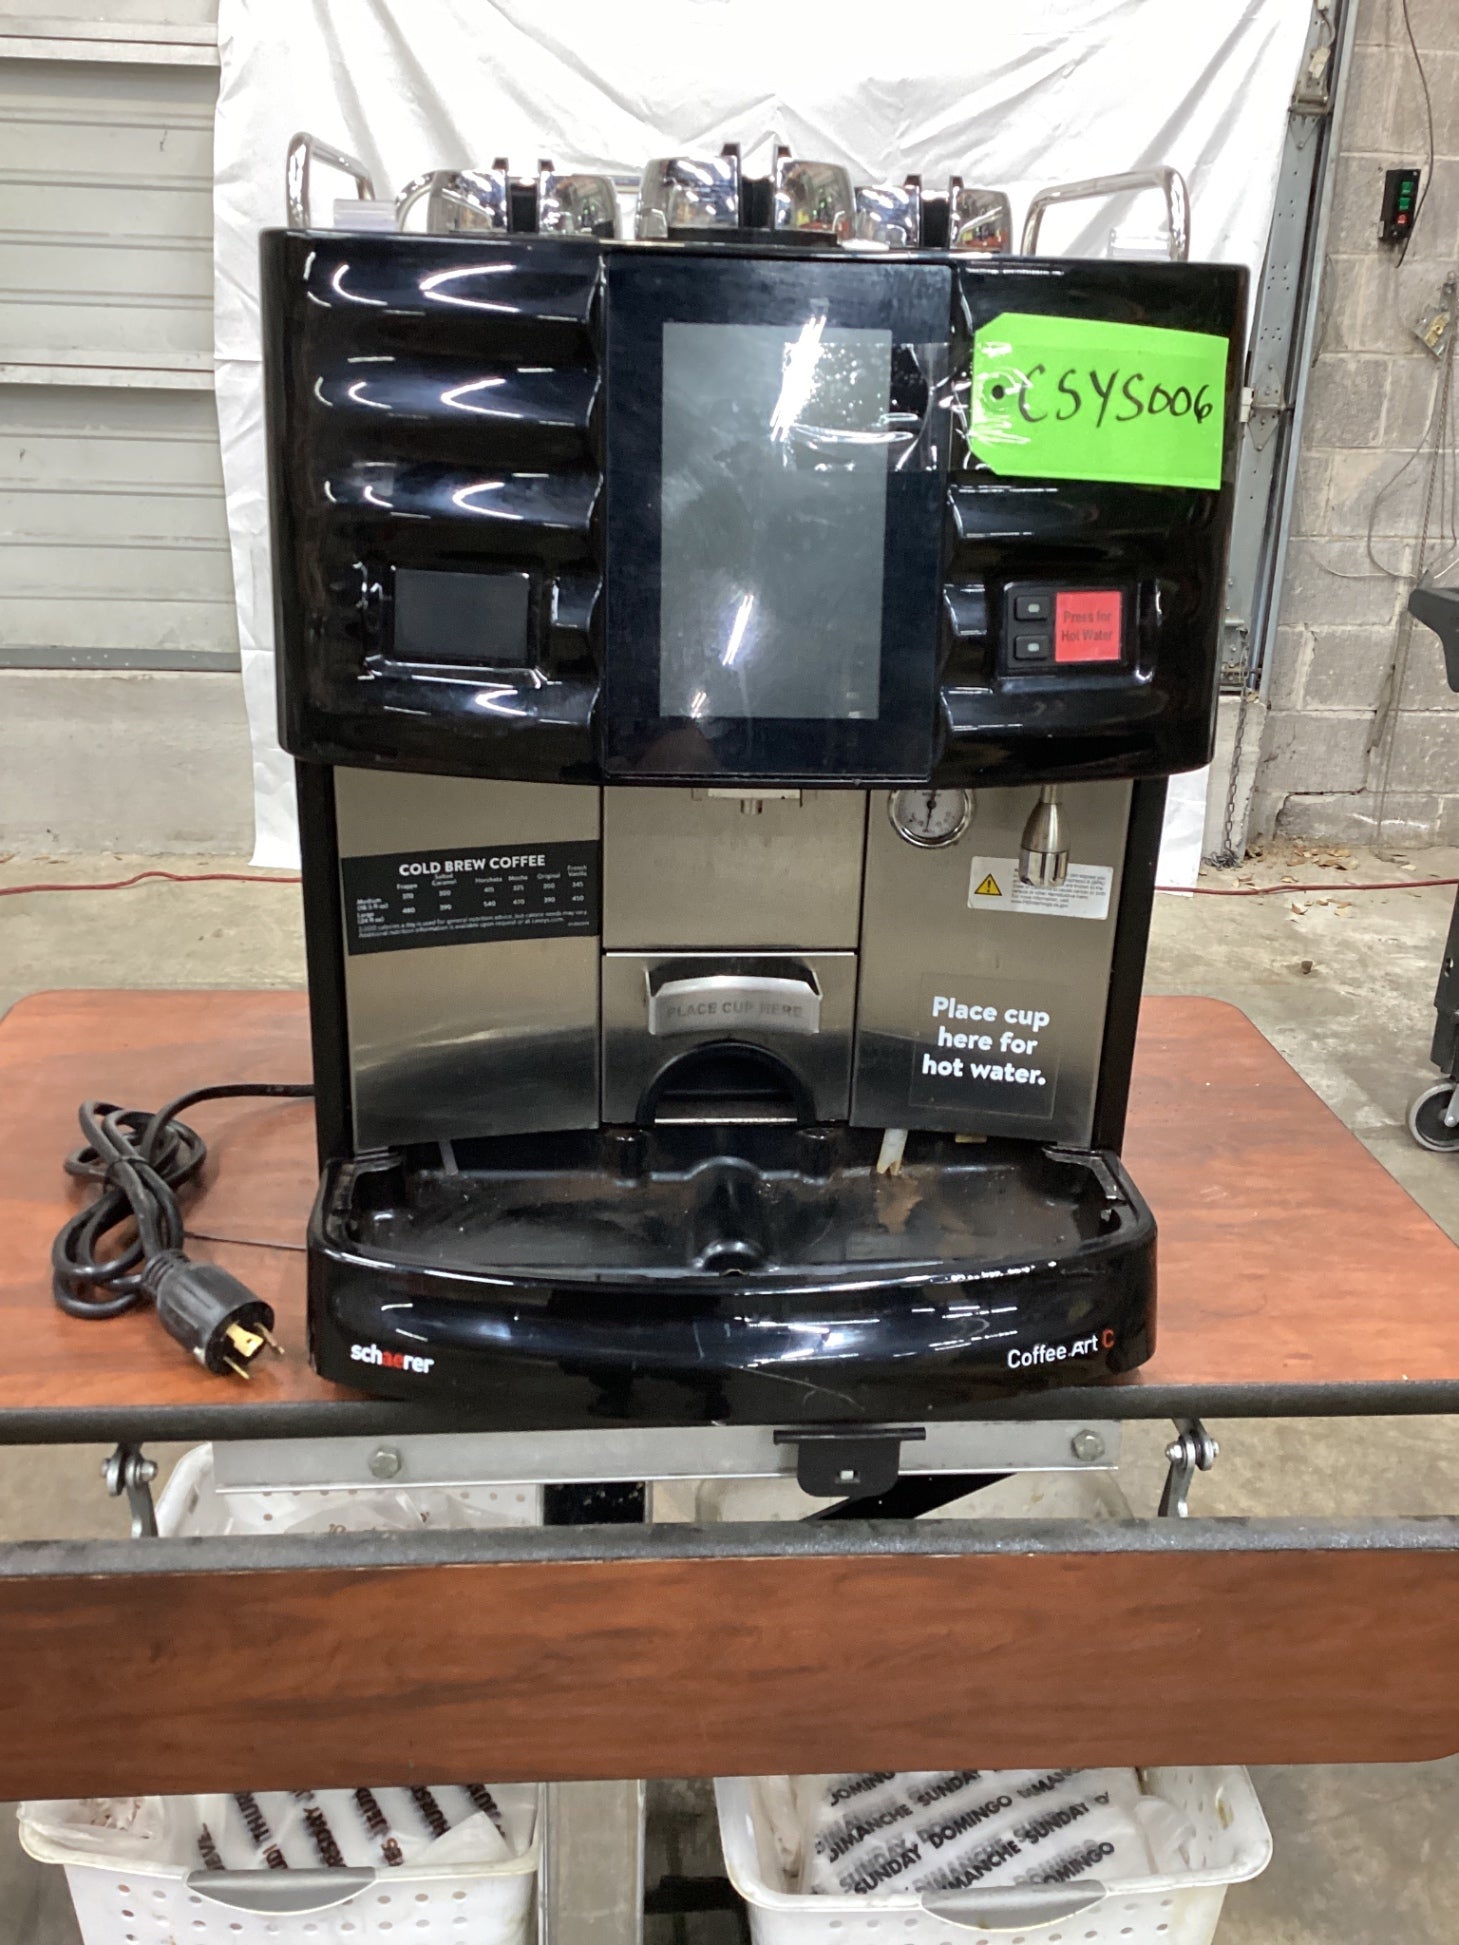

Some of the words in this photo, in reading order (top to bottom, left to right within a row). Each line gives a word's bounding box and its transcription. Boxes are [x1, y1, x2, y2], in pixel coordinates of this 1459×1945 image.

[1018, 363, 1213, 428] CSYS006
[1063, 610, 1094, 623] Press
[1083, 629, 1114, 641] Water
[398, 863, 441, 876] COLD
[444, 857, 486, 872] BREW
[489, 854, 546, 869] COFFEE
[667, 1002, 717, 1018] PLACE
[722, 1001, 753, 1014] CUP
[759, 1001, 803, 1018] HERE
[932, 996, 998, 1022] Place
[1004, 1008, 1050, 1032] cup
[937, 1025, 993, 1051] here
[999, 1031, 1039, 1055] for
[921, 1053, 964, 1078] hot
[970, 1063, 1047, 1086] water.
[350, 1343, 435, 1374] schaerer
[1007, 1344, 1067, 1369] Coffee
[1070, 1334, 1098, 1357] Art
[1101, 1328, 1114, 1349] C
[1025, 1802, 1090, 1844] SUNDAY
[854, 1843, 922, 1894] SUNDAY
[928, 1795, 1013, 1849] DOMINGO
